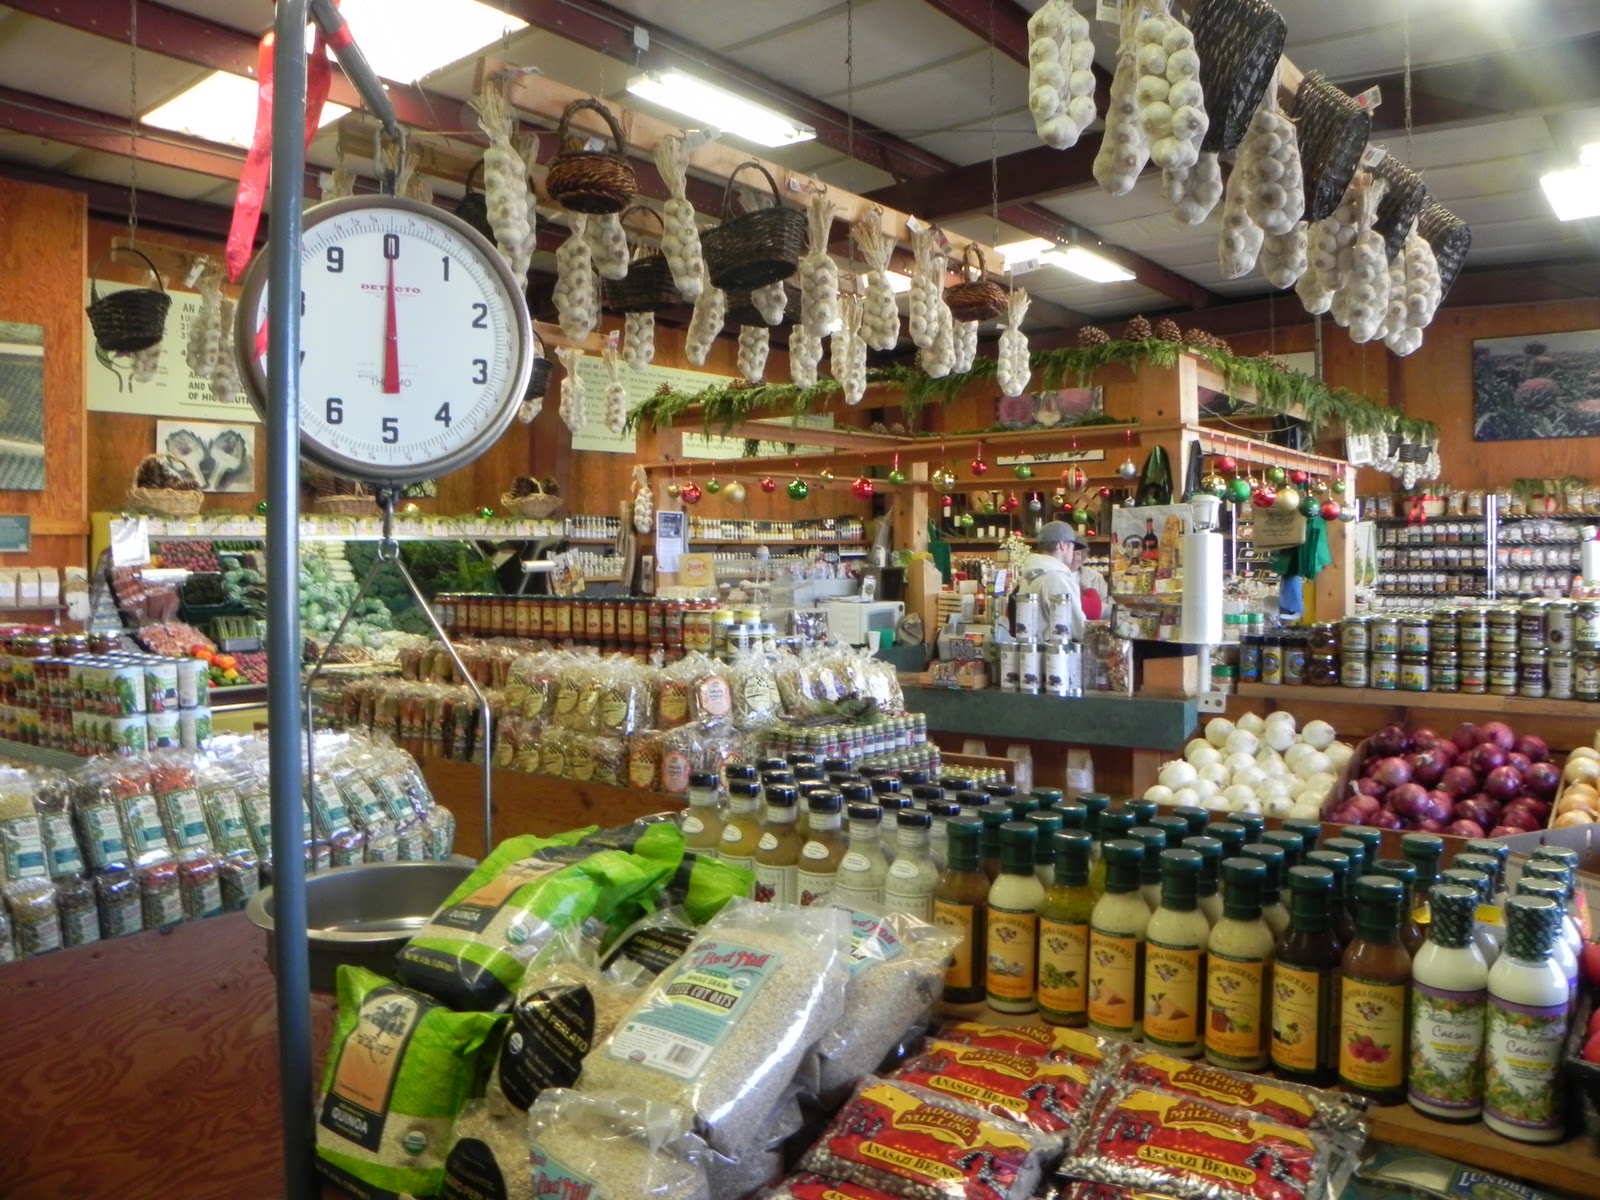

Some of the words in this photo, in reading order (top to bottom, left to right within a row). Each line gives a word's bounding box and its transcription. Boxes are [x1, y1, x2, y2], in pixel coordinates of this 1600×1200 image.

[383, 233, 400, 260] 0
[326, 246, 344, 273] 9
[441, 256, 450, 282] 1
[361, 284, 421, 293] DETCTO
[472, 303, 488, 329] 2
[472, 359, 488, 384] 3
[326, 398, 343, 424] 6
[435, 402, 452, 428] 4
[382, 418, 399, 444] 5
[1432, 1024, 1472, 1041] Caesar
[1506, 1040, 1549, 1057] Caesar
[932, 1076, 979, 1096] ANASAZI
[1176, 1073, 1250, 1098] MILLING
[904, 1113, 974, 1138] MILLING
[919, 1105, 973, 1126] ADOBE
[863, 1143, 913, 1167] ANASAZI
[1140, 1146, 1199, 1170] ANASAZI
[1458, 1171, 1545, 1200] LUNDBER
